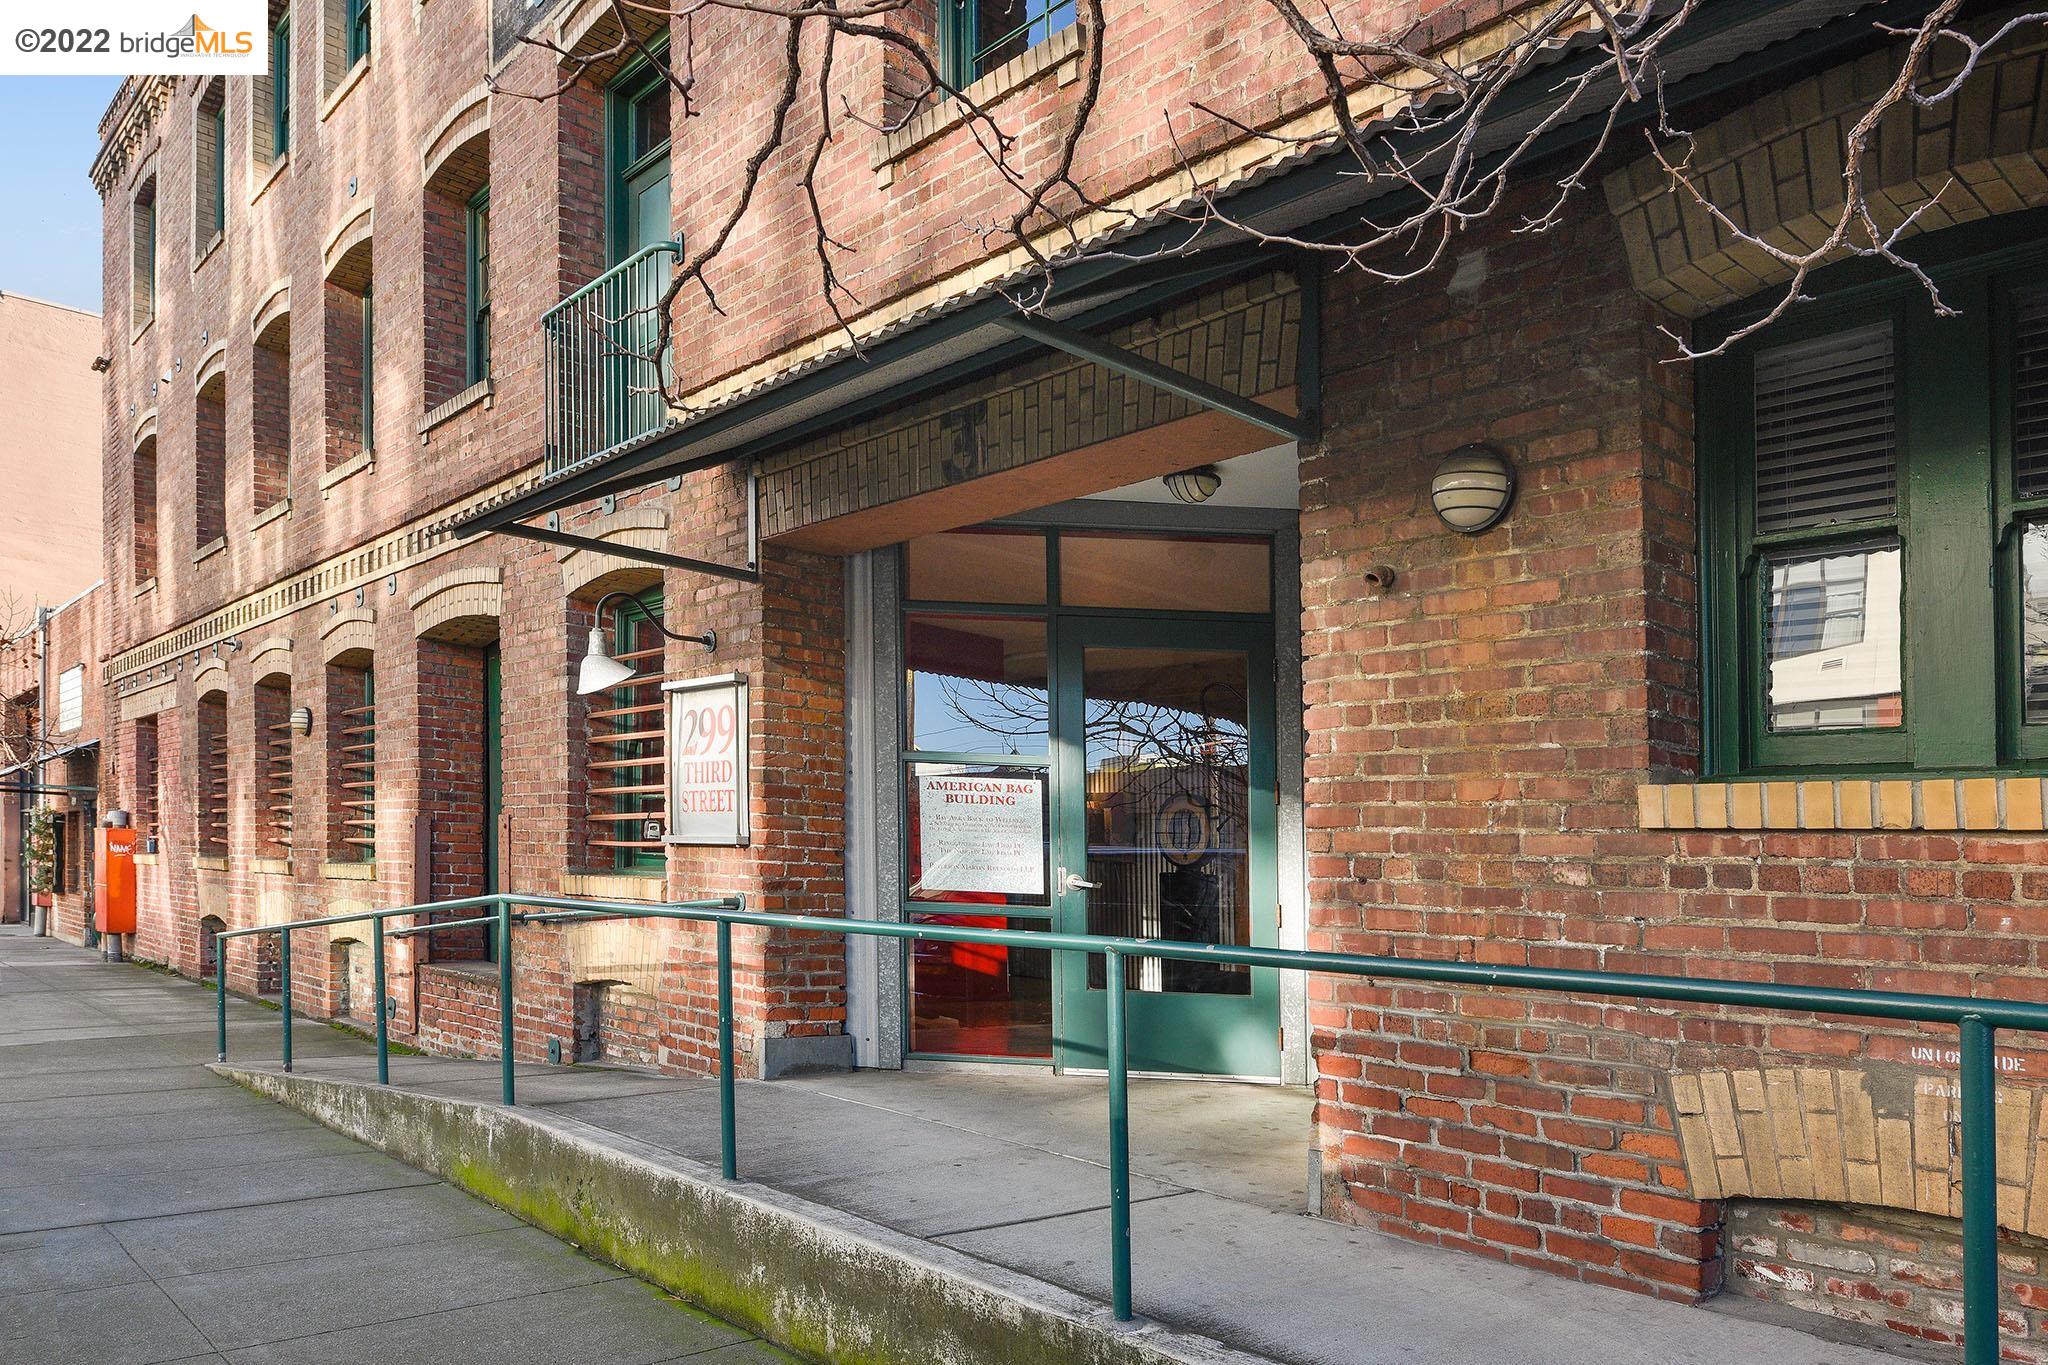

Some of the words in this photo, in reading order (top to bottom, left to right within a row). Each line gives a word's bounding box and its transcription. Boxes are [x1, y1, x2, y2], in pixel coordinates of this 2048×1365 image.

[682, 704, 736, 756] 299
[684, 760, 733, 785] THIRD
[926, 780, 1002, 794] AMERICAN
[1006, 783, 1034, 795] BAG
[945, 793, 1016, 806] BUILDING
[682, 789, 736, 813] STREET
